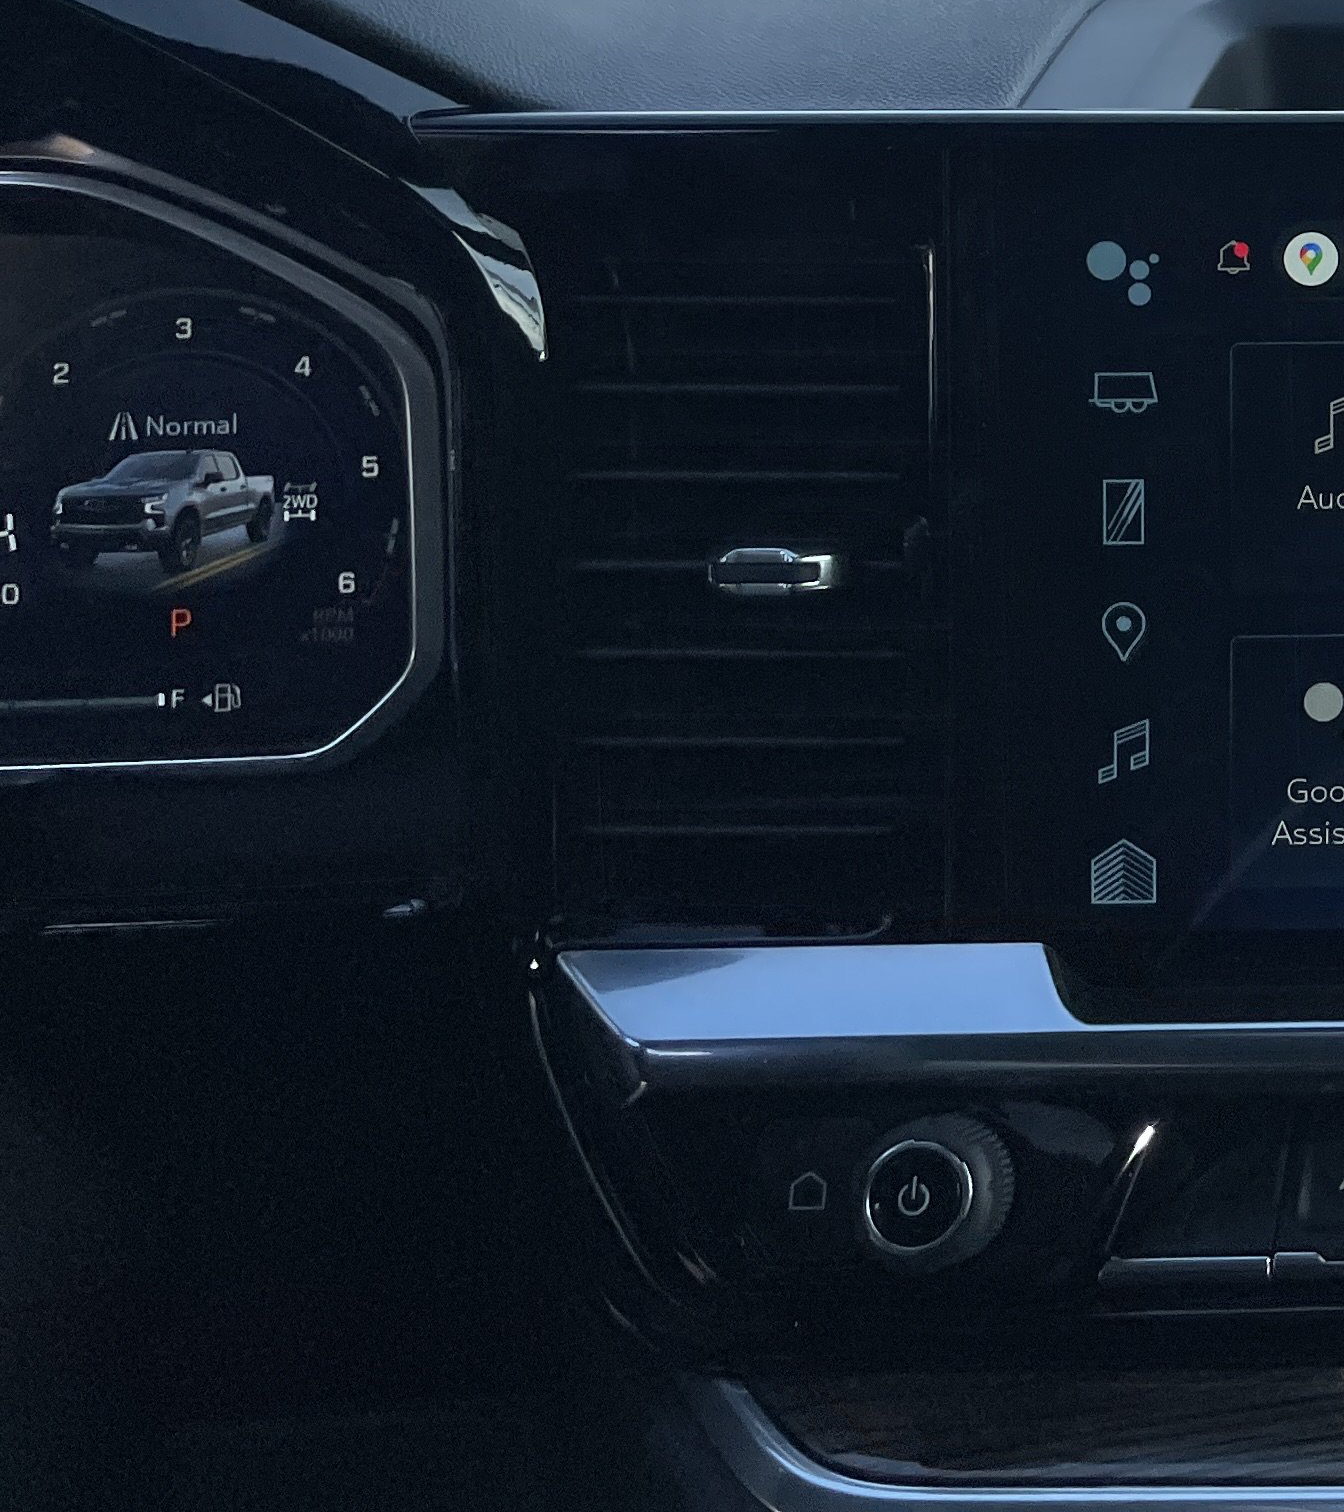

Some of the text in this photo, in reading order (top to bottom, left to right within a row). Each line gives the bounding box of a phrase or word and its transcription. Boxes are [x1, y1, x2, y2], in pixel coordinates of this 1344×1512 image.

[175, 317, 193, 339] 3
[53, 363, 70, 384] 2
[294, 355, 312, 377] 4
[146, 412, 238, 437] Normal
[362, 455, 379, 478] 5
[283, 495, 318, 510] 2WD
[338, 571, 356, 593] 6
[170, 608, 192, 638] P
[171, 689, 185, 709] F
